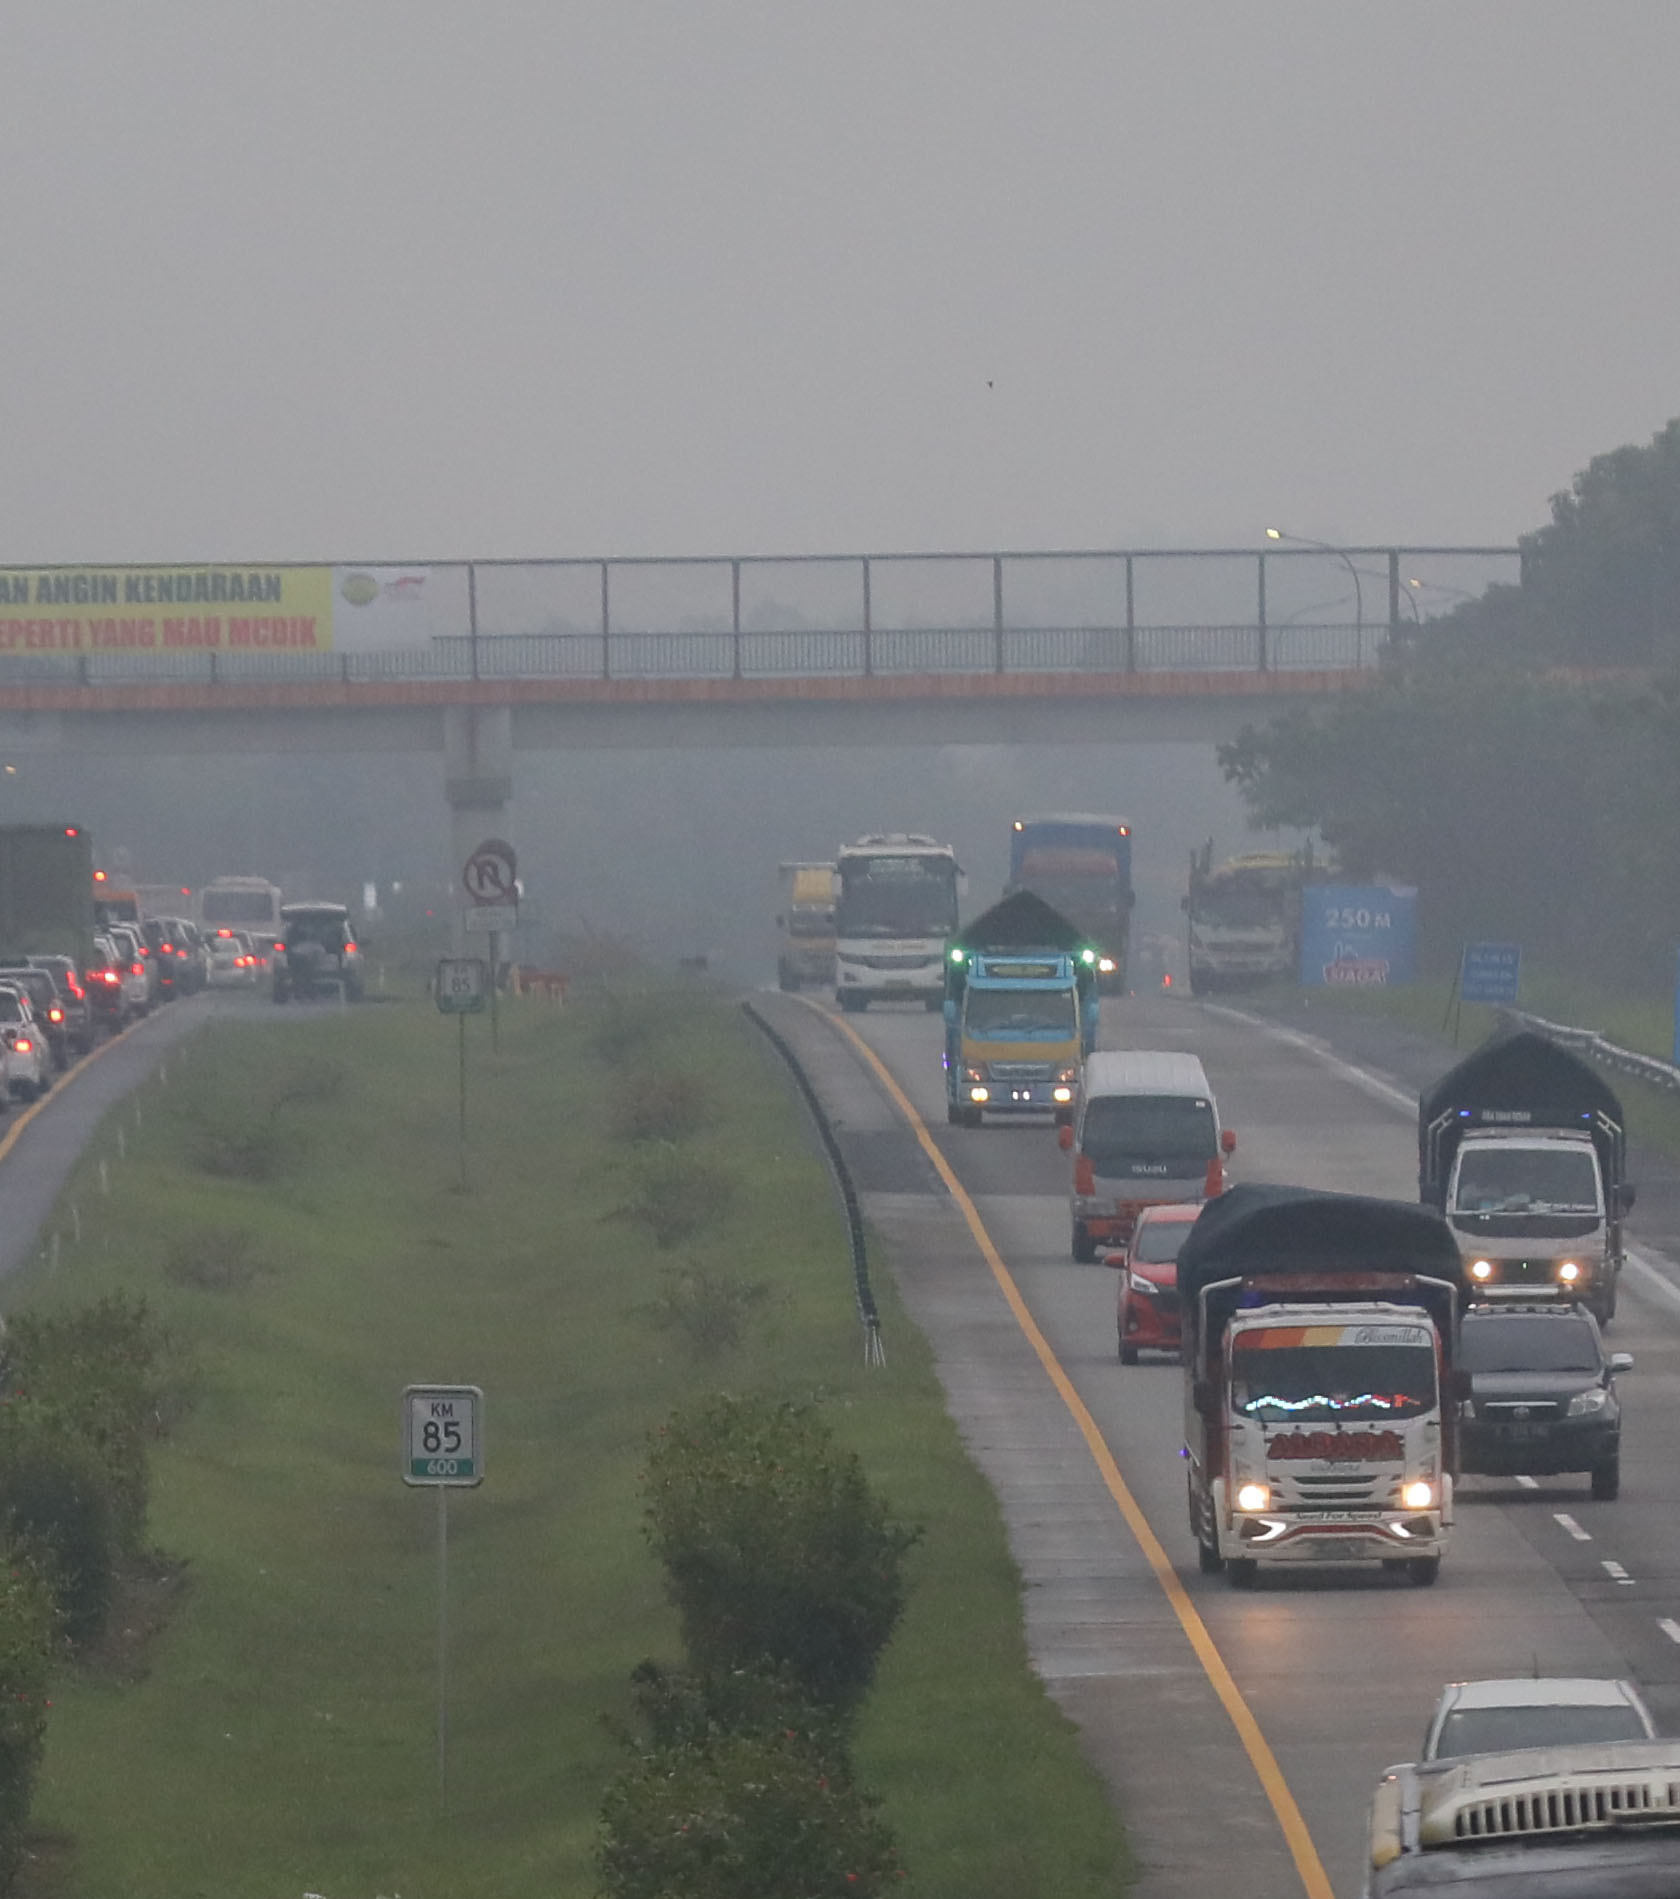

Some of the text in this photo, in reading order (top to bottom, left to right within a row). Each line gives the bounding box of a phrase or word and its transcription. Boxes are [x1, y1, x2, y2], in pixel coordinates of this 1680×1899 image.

[37, 574, 118, 603] ANGIN
[125, 573, 282, 603] KENDARAAN
[88, 618, 155, 648] YANG
[163, 617, 221, 647] MAU
[1325, 907, 1391, 929] 250 M
[431, 1403, 454, 1417] KM
[422, 1421, 462, 1453] 85
[427, 1460, 458, 1474] 600
